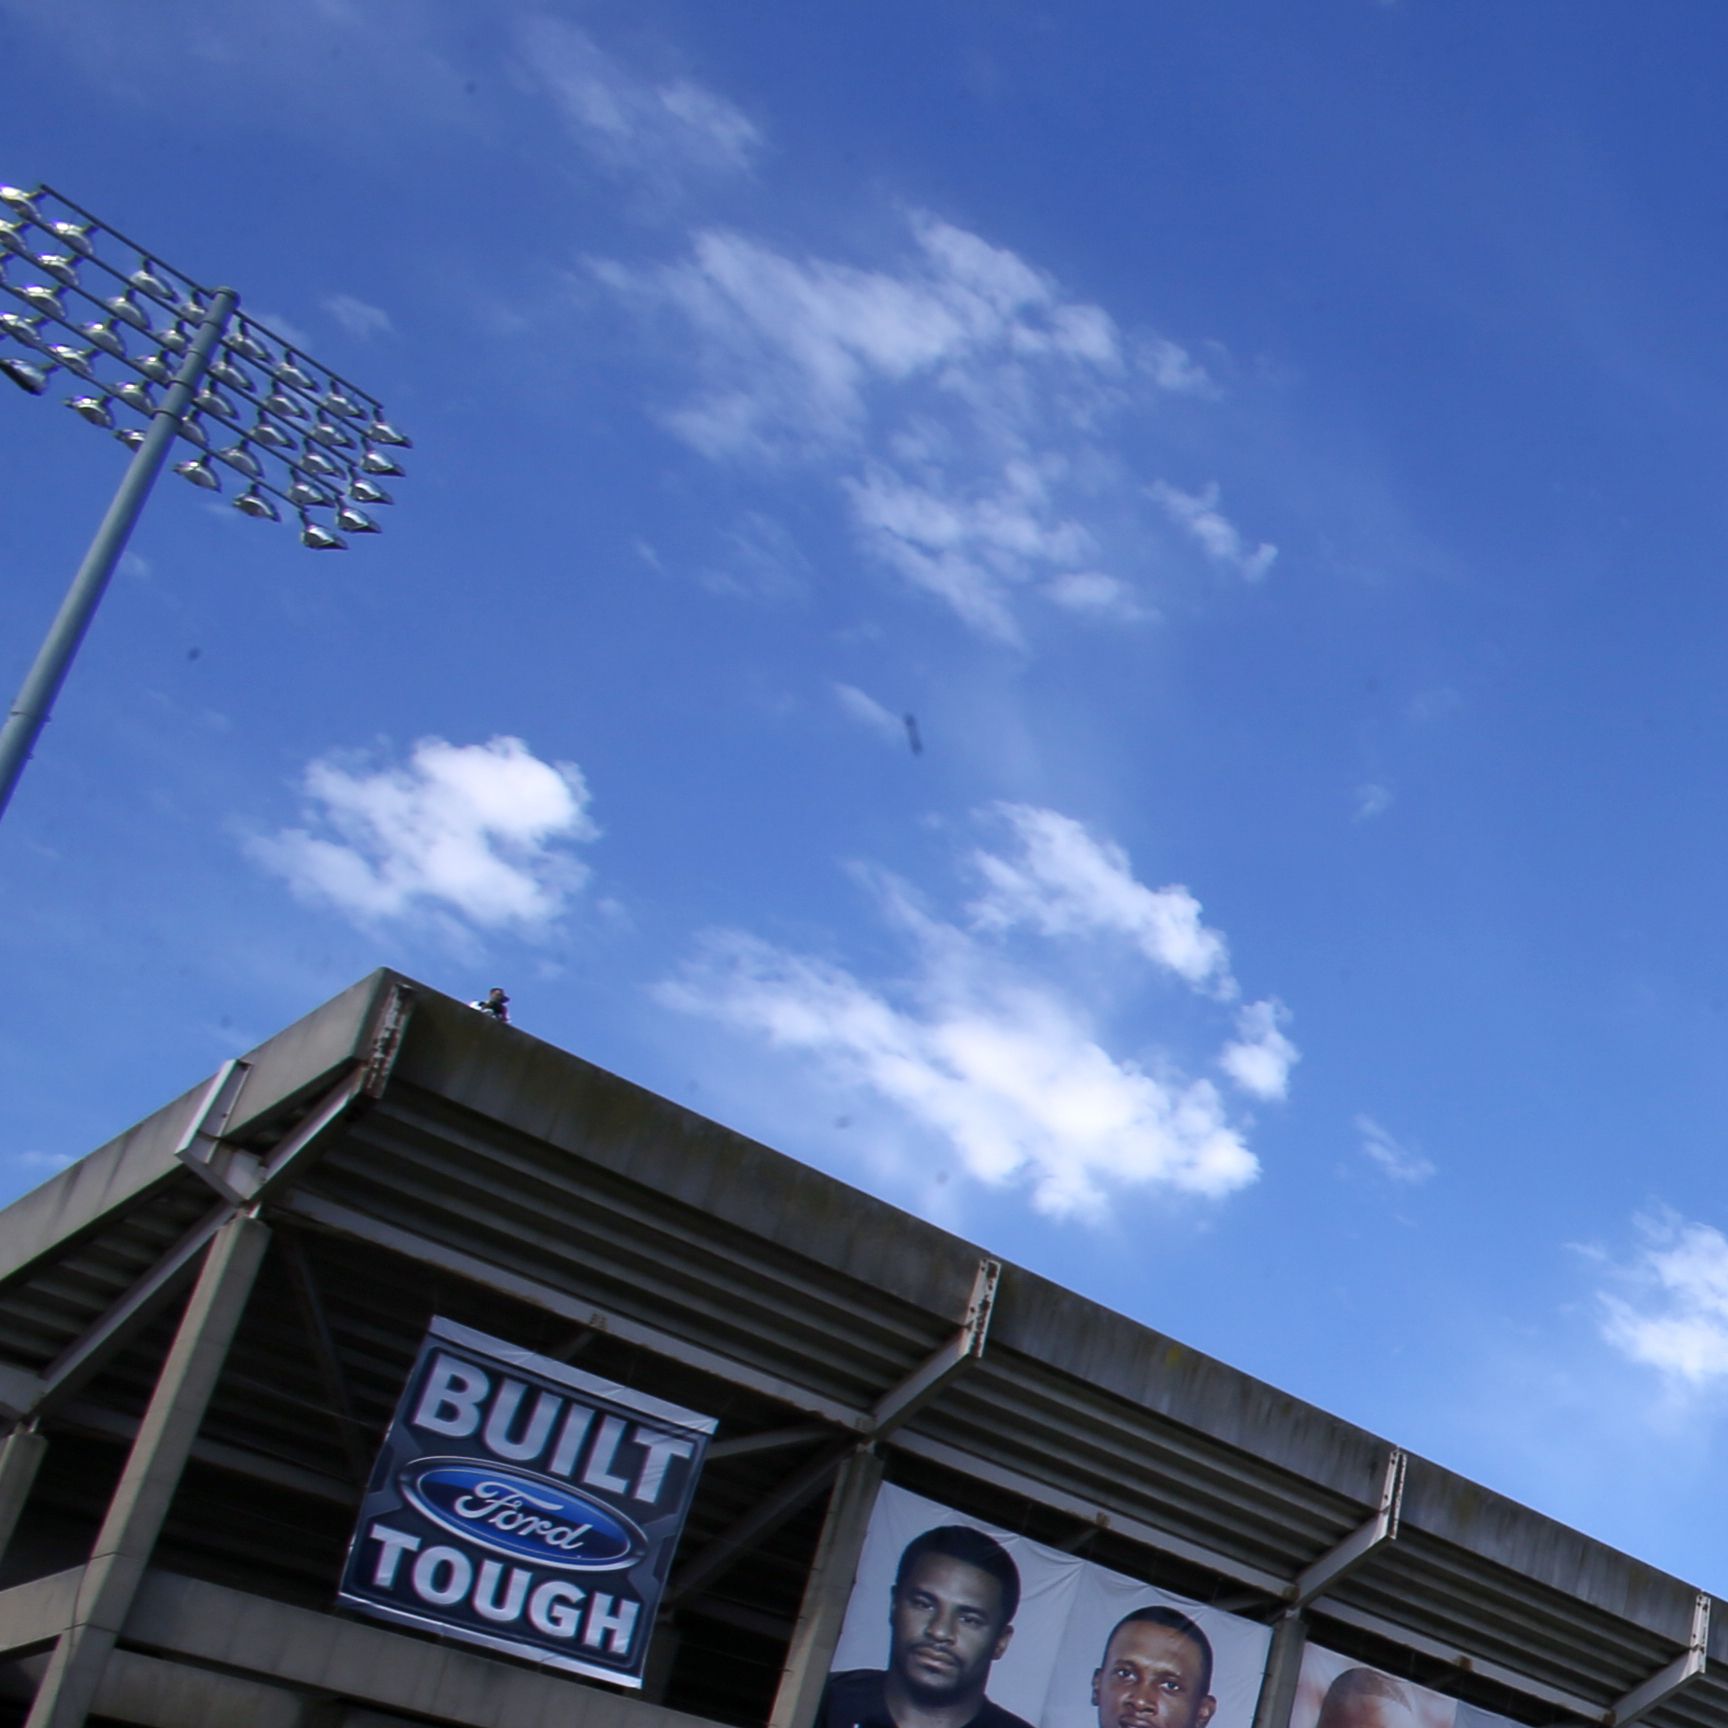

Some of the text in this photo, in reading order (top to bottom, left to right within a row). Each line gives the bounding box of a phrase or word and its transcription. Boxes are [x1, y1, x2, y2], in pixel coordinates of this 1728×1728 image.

[412, 1353, 695, 1503] BUILT
[454, 1481, 592, 1550] Ford
[370, 1524, 640, 1655] TOUGH
